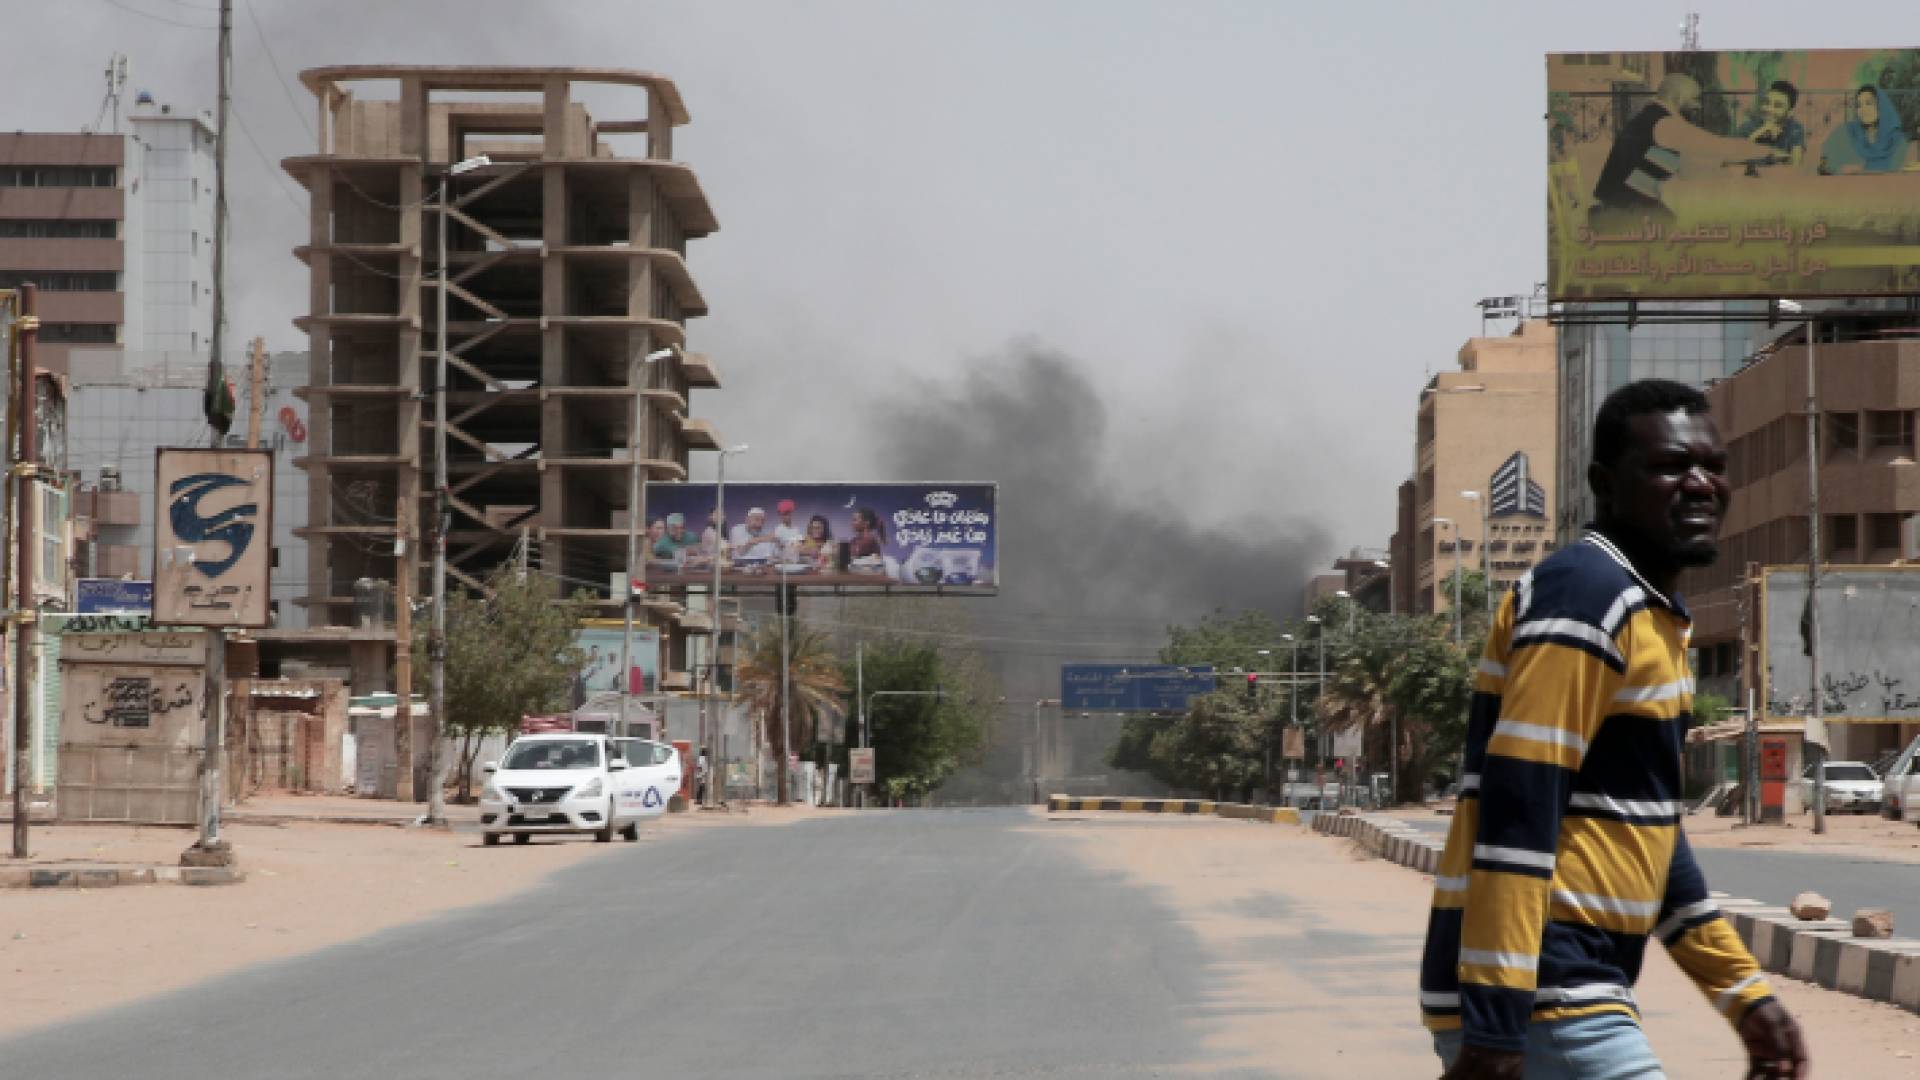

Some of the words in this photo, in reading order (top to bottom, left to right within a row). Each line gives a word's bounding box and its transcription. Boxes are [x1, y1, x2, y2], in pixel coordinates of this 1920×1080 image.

[1577, 215, 1664, 249] الأسرة
[1664, 222, 1730, 249] تنظيم
[1800, 218, 1828, 245] قرر
[1663, 248, 1697, 282] الأم
[1701, 255, 1754, 275] صحة
[1799, 255, 1828, 277] من
[950, 509, 989, 526] رمضان
[934, 526, 962, 544] غير
